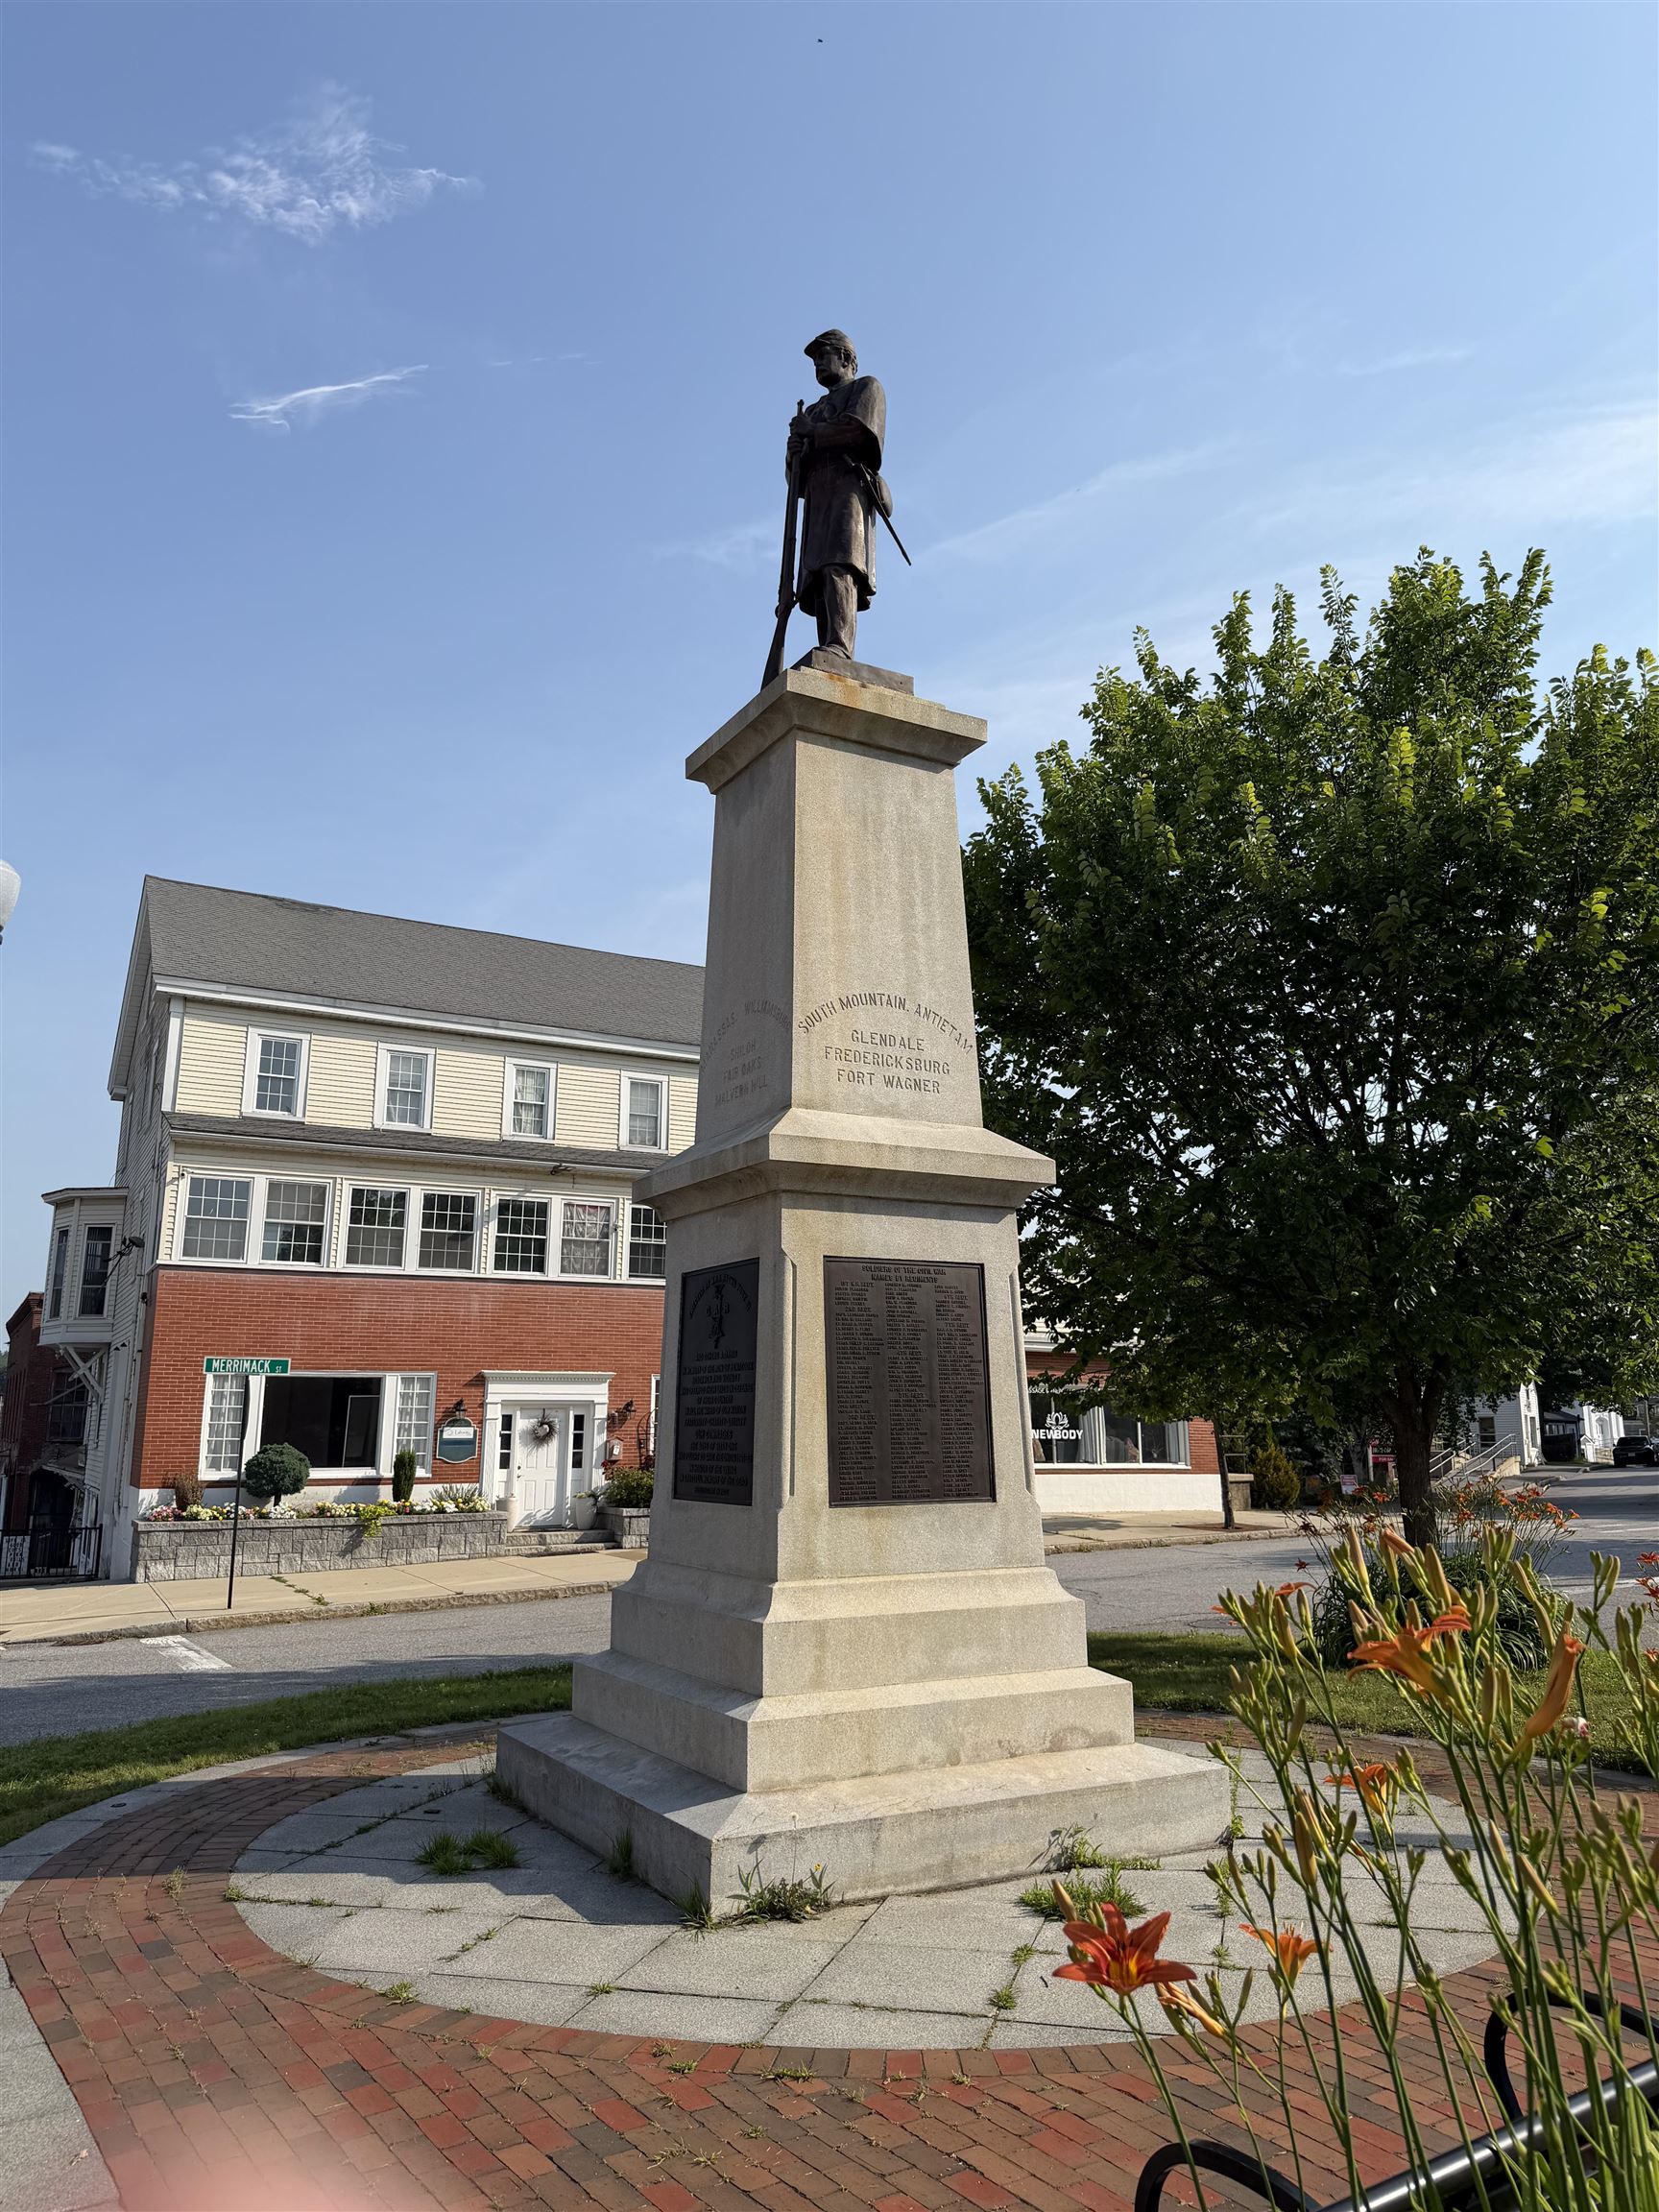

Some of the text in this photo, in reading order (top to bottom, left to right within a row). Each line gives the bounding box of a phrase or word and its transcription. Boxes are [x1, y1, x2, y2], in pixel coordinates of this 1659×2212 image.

[798, 999, 838, 1035] SOUTH
[913, 1003, 974, 1056] ANTIETAM
[851, 1029, 926, 1052] GLENDALE
[824, 1046, 951, 1075] FREDERICKSBURG
[837, 1069, 941, 1094] FORT WAGNER
[212, 1358, 271, 1373] MERRIMACK
